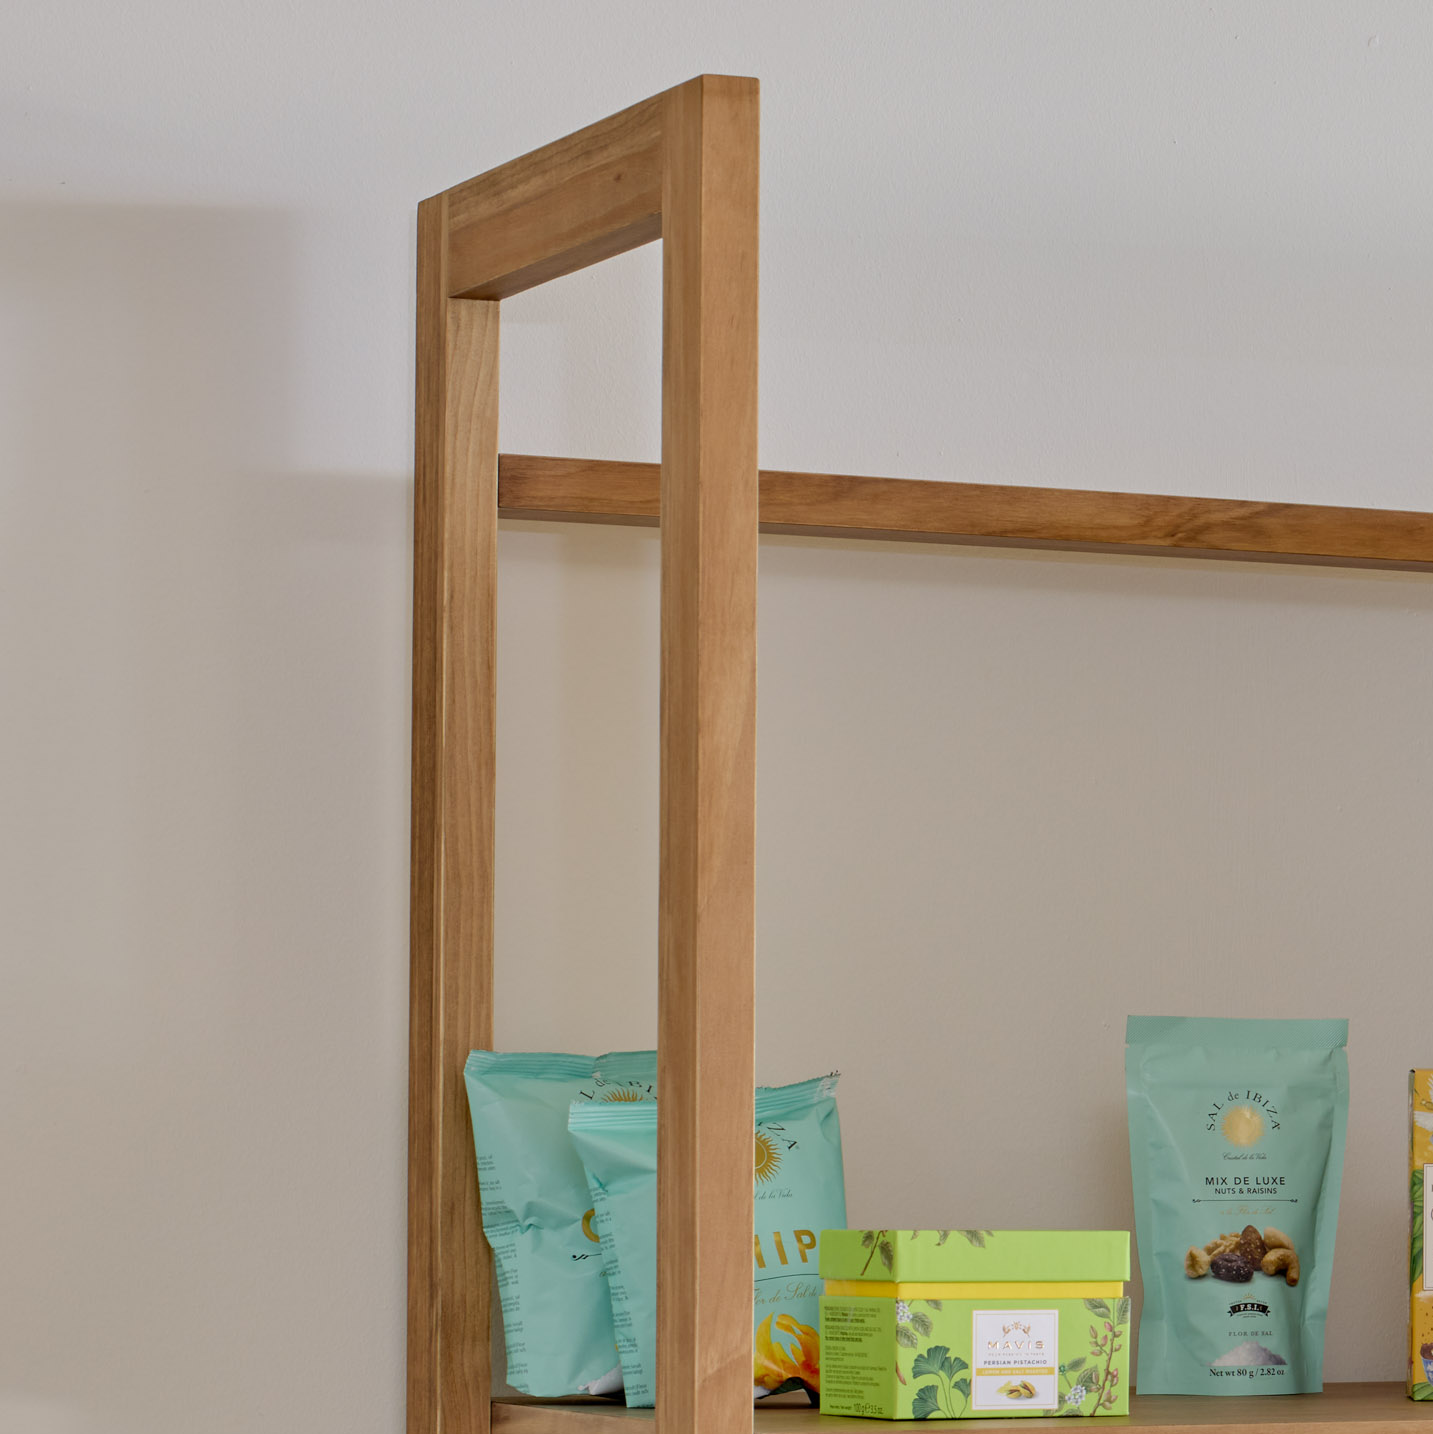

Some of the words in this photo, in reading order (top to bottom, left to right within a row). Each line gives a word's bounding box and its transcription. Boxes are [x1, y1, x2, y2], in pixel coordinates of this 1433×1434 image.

[1206, 1102, 1224, 1131] SAL
[1227, 1091, 1239, 1102] de
[1246, 1090, 1280, 1130] IBIZA
[1205, 1176, 1228, 1186] MIX
[1234, 1176, 1250, 1185] DE
[1255, 1176, 1286, 1186] LUXE
[988, 1341, 1045, 1349] MAVIS
[1209, 1369, 1224, 1377] Net
[1249, 1370, 1254, 1379] g
[1260, 1368, 1276, 1376] 2.82
